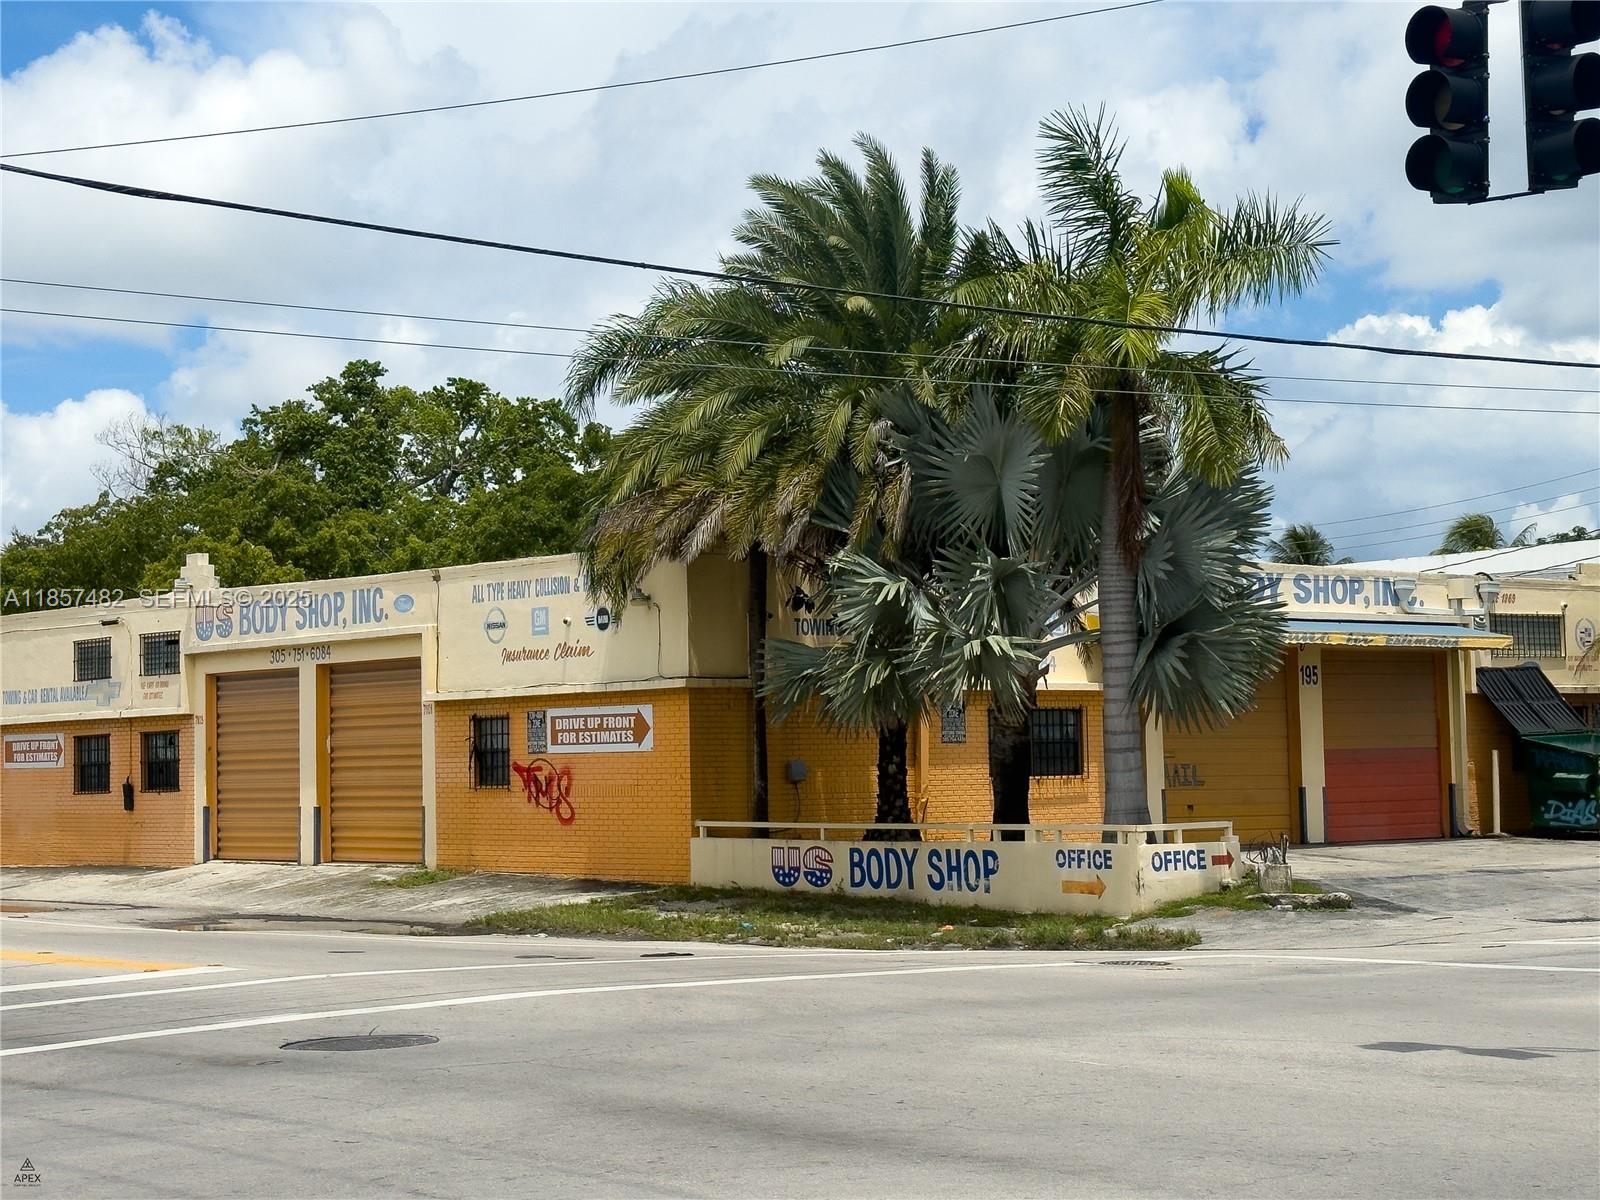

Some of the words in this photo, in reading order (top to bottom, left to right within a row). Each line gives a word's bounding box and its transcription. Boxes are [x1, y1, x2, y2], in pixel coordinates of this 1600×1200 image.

[472, 585, 485, 603] ALL
[487, 582, 504, 600] TYPE
[508, 580, 532, 600] HEAVY
[535, 576, 570, 598] COLLISION
[574, 578, 580, 592] &
[1293, 573, 1370, 609] SHOP,
[1373, 576, 1425, 608] IN.
[195, 602, 234, 642] US
[239, 600, 288, 636] BODY
[295, 591, 347, 630] SHOP,
[352, 587, 389, 625] INC.
[534, 609, 546, 625] GM
[486, 621, 506, 630] NISSAN
[501, 646, 550, 665] Insurance
[553, 639, 595, 661] Claim
[1300, 665, 1318, 686] 195
[555, 720, 585, 730] DRIVE
[587, 718, 600, 729] UP
[603, 716, 636, 728] FRONT
[12, 742, 30, 751] DRIVE
[30, 742, 39, 750] UP
[557, 732, 577, 744] FOR
[579, 730, 634, 743] ESTIMATES
[13, 753, 25, 762] FOR
[26, 752, 58, 761] ESTIMATES
[771, 845, 834, 888] US
[849, 847, 919, 890] BODY
[927, 848, 999, 894] SHOP
[1055, 849, 1113, 870] OFFICE
[1151, 849, 1207, 872] OFFICE
